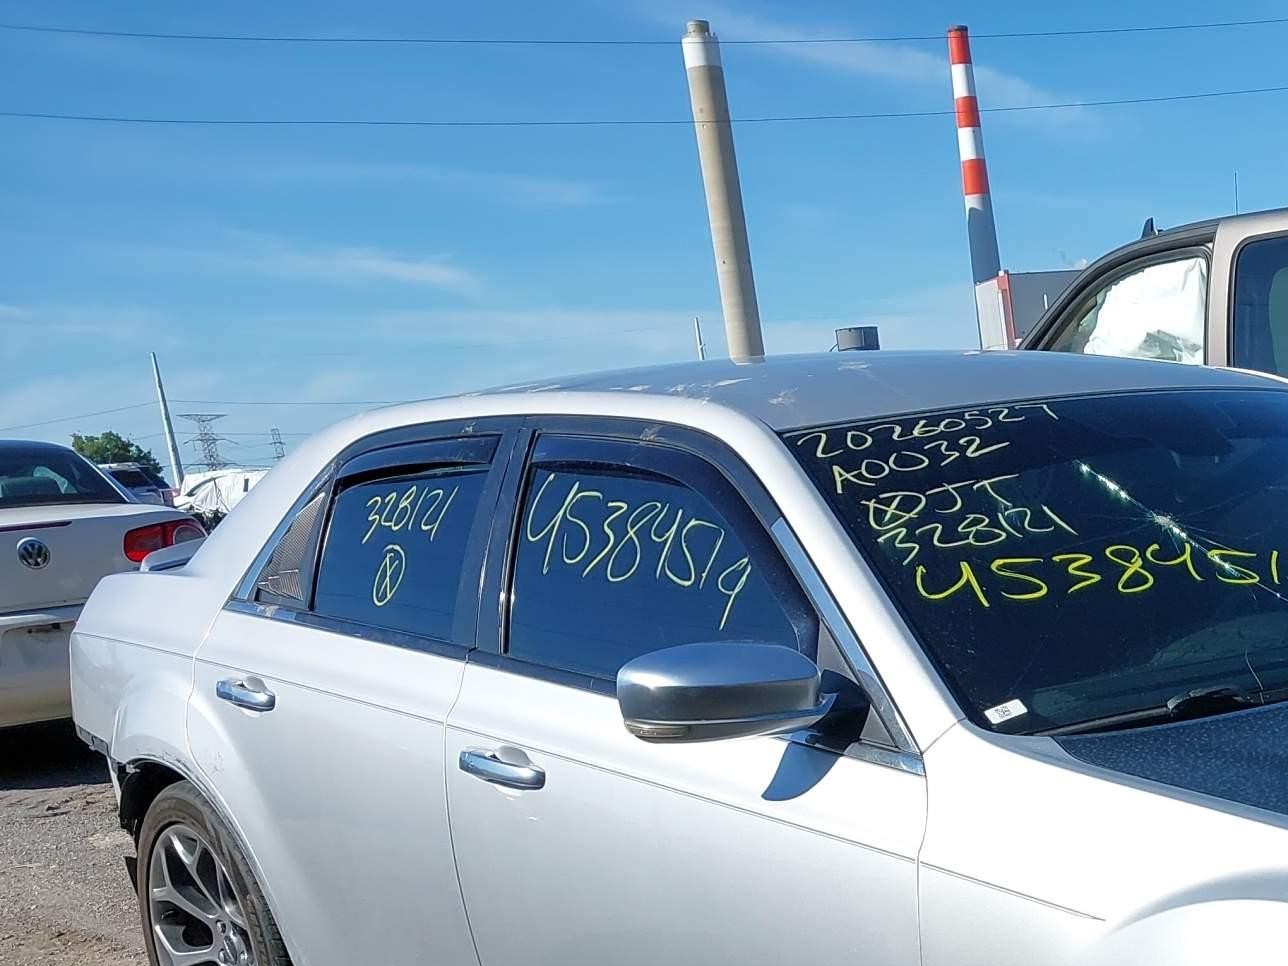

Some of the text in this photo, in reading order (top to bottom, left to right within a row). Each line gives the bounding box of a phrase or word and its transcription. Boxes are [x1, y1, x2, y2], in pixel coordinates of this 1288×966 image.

[797, 404, 1059, 458] 20260527
[832, 436, 1010, 494] A0032
[362, 485, 459, 544] 328121
[877, 503, 1079, 565] 328121
[527, 473, 752, 630] 45384519
